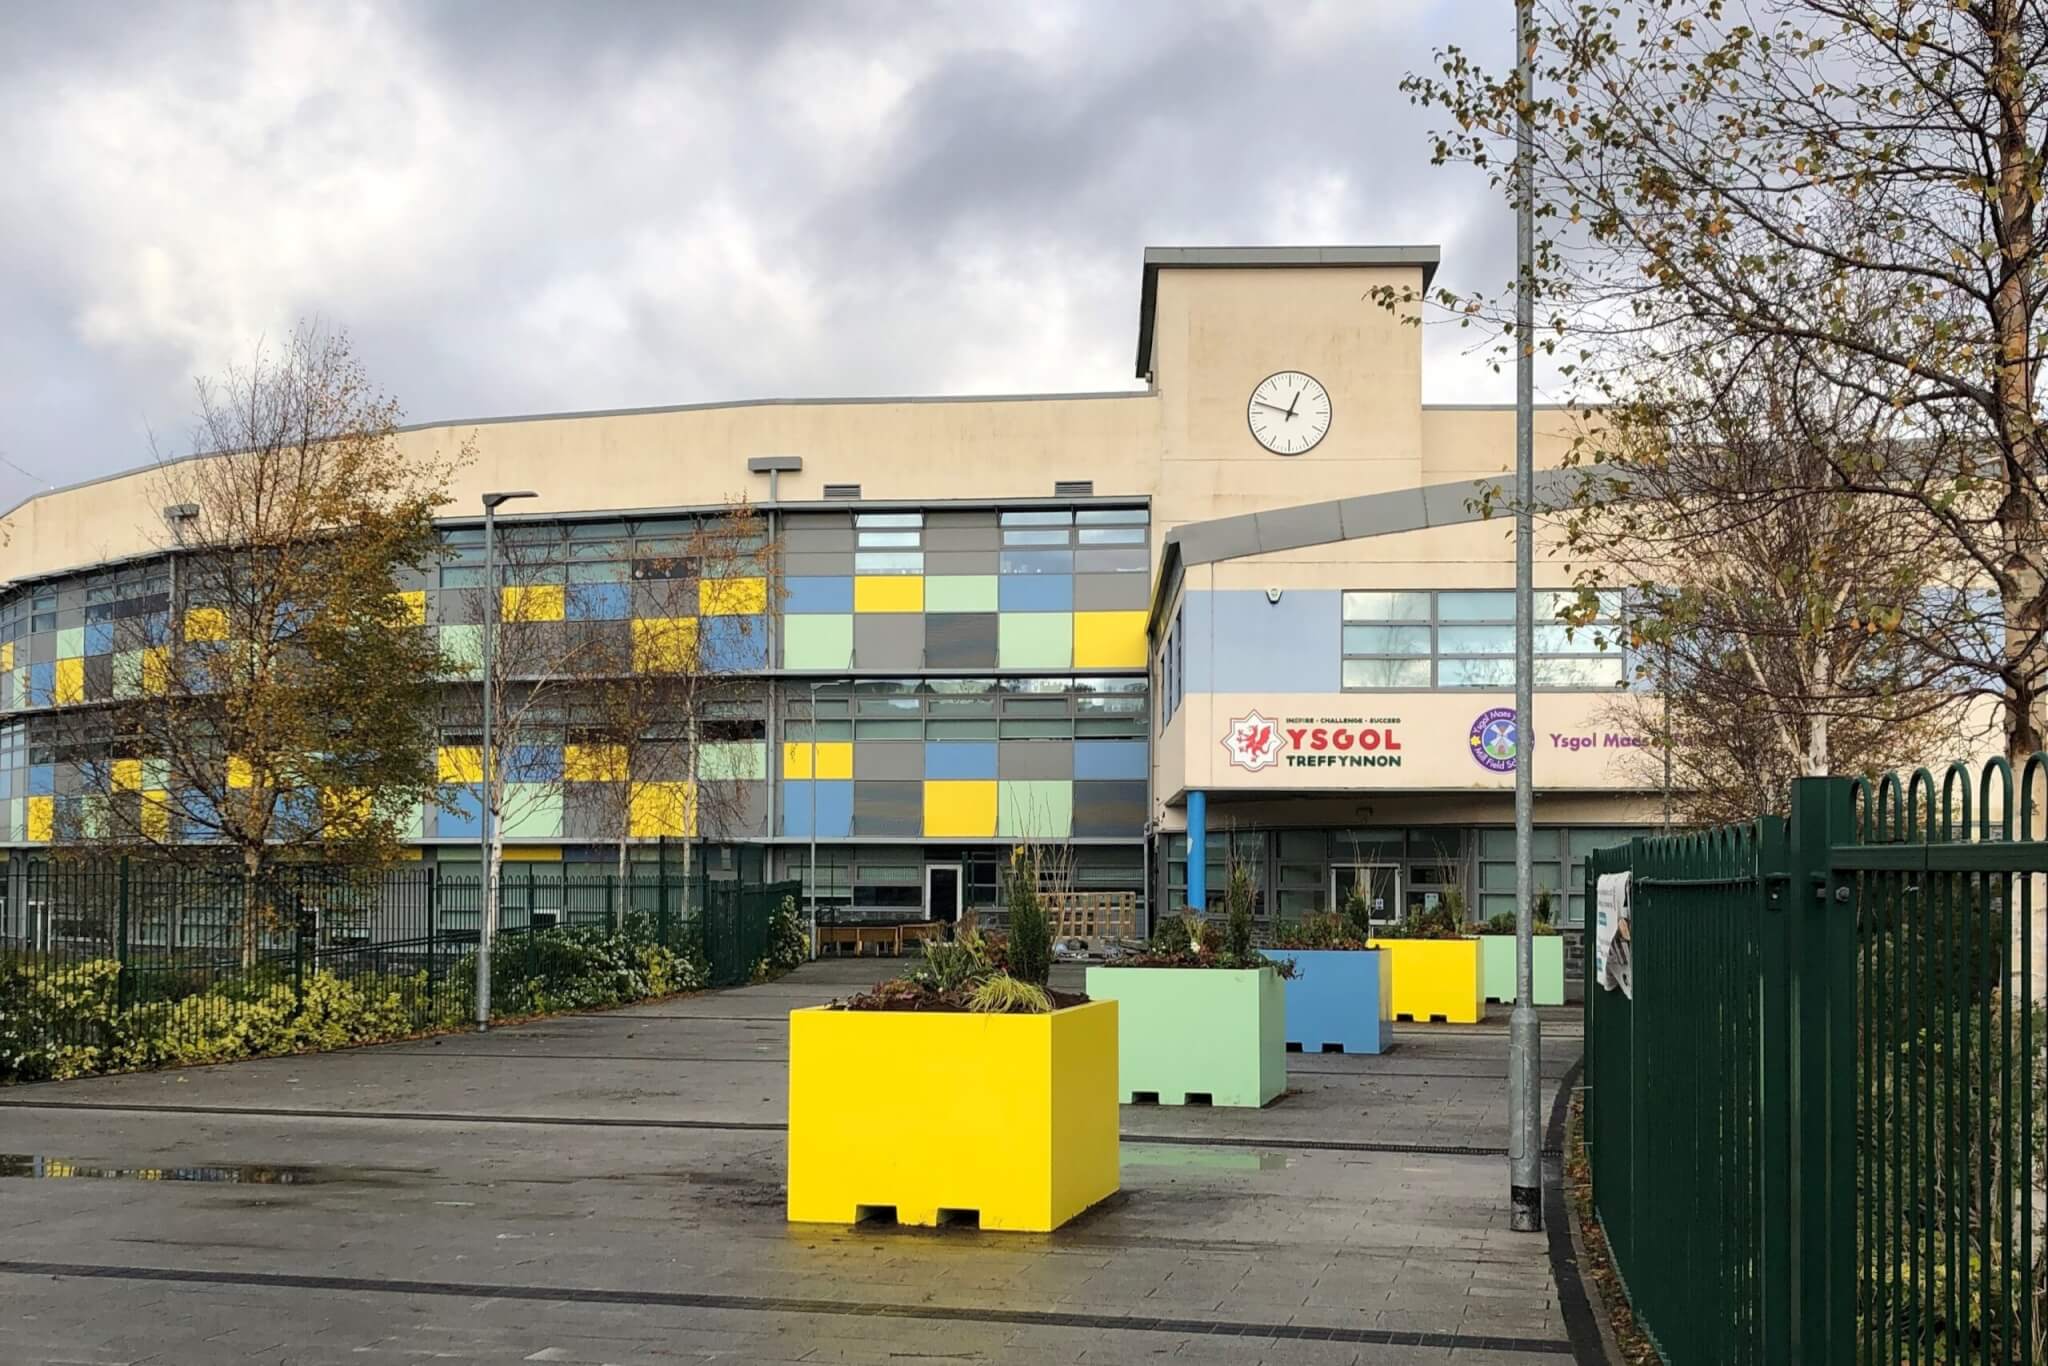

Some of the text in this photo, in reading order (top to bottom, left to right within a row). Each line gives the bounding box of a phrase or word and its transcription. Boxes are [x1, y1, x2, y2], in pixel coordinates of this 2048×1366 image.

[1490, 710, 1512, 720] Maes
[1286, 728, 1401, 751] YSGOL
[1549, 732, 1597, 751] Ysgol
[1603, 733, 1648, 748] Maes
[1286, 755, 1401, 767] TREFFYNNON
[1486, 758, 1505, 770] Field
